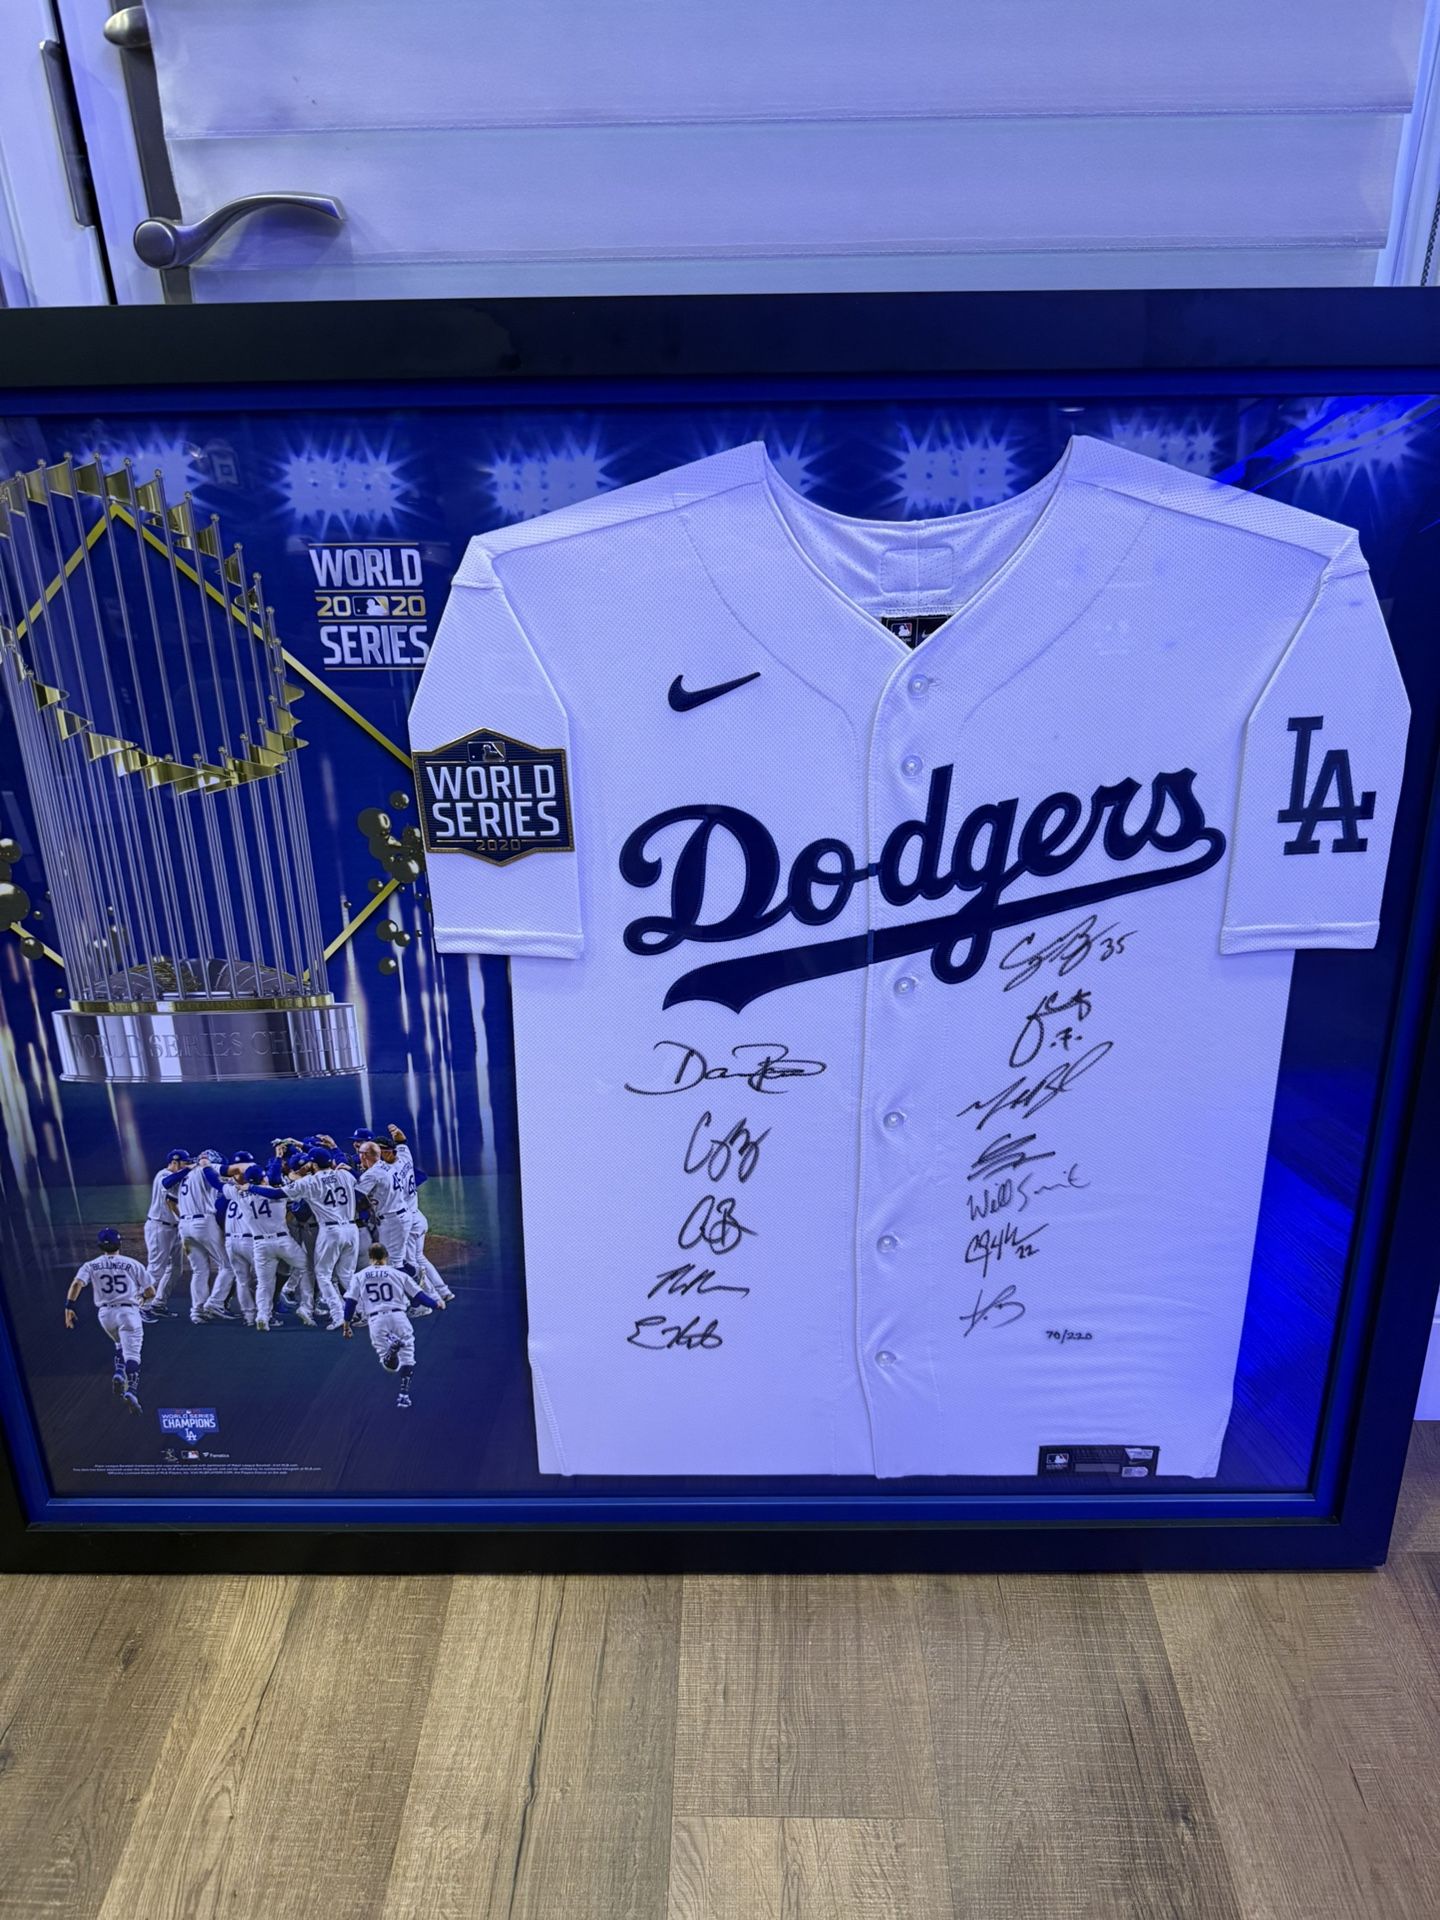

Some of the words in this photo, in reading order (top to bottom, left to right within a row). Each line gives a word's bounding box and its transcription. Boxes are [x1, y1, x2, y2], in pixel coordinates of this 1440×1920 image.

[309, 548, 423, 587] WORLD
[319, 624, 430, 665] SERIES
[426, 764, 556, 800] WORLD
[1277, 715, 1377, 855] LA
[432, 800, 560, 837] SERIES
[475, 838, 521, 851] 2020
[619, 764, 1226, 984] Dodgers
[323, 1186, 349, 1208] 43
[249, 1199, 273, 1220] 14
[100, 1274, 128, 1294] 35
[365, 1270, 389, 1280] BETTS
[366, 1282, 394, 1302] 50
[1045, 1329, 1093, 1344] 70/220
[162, 1418, 217, 1429] CHAMPIONS
[185, 1428, 197, 1441] LA
